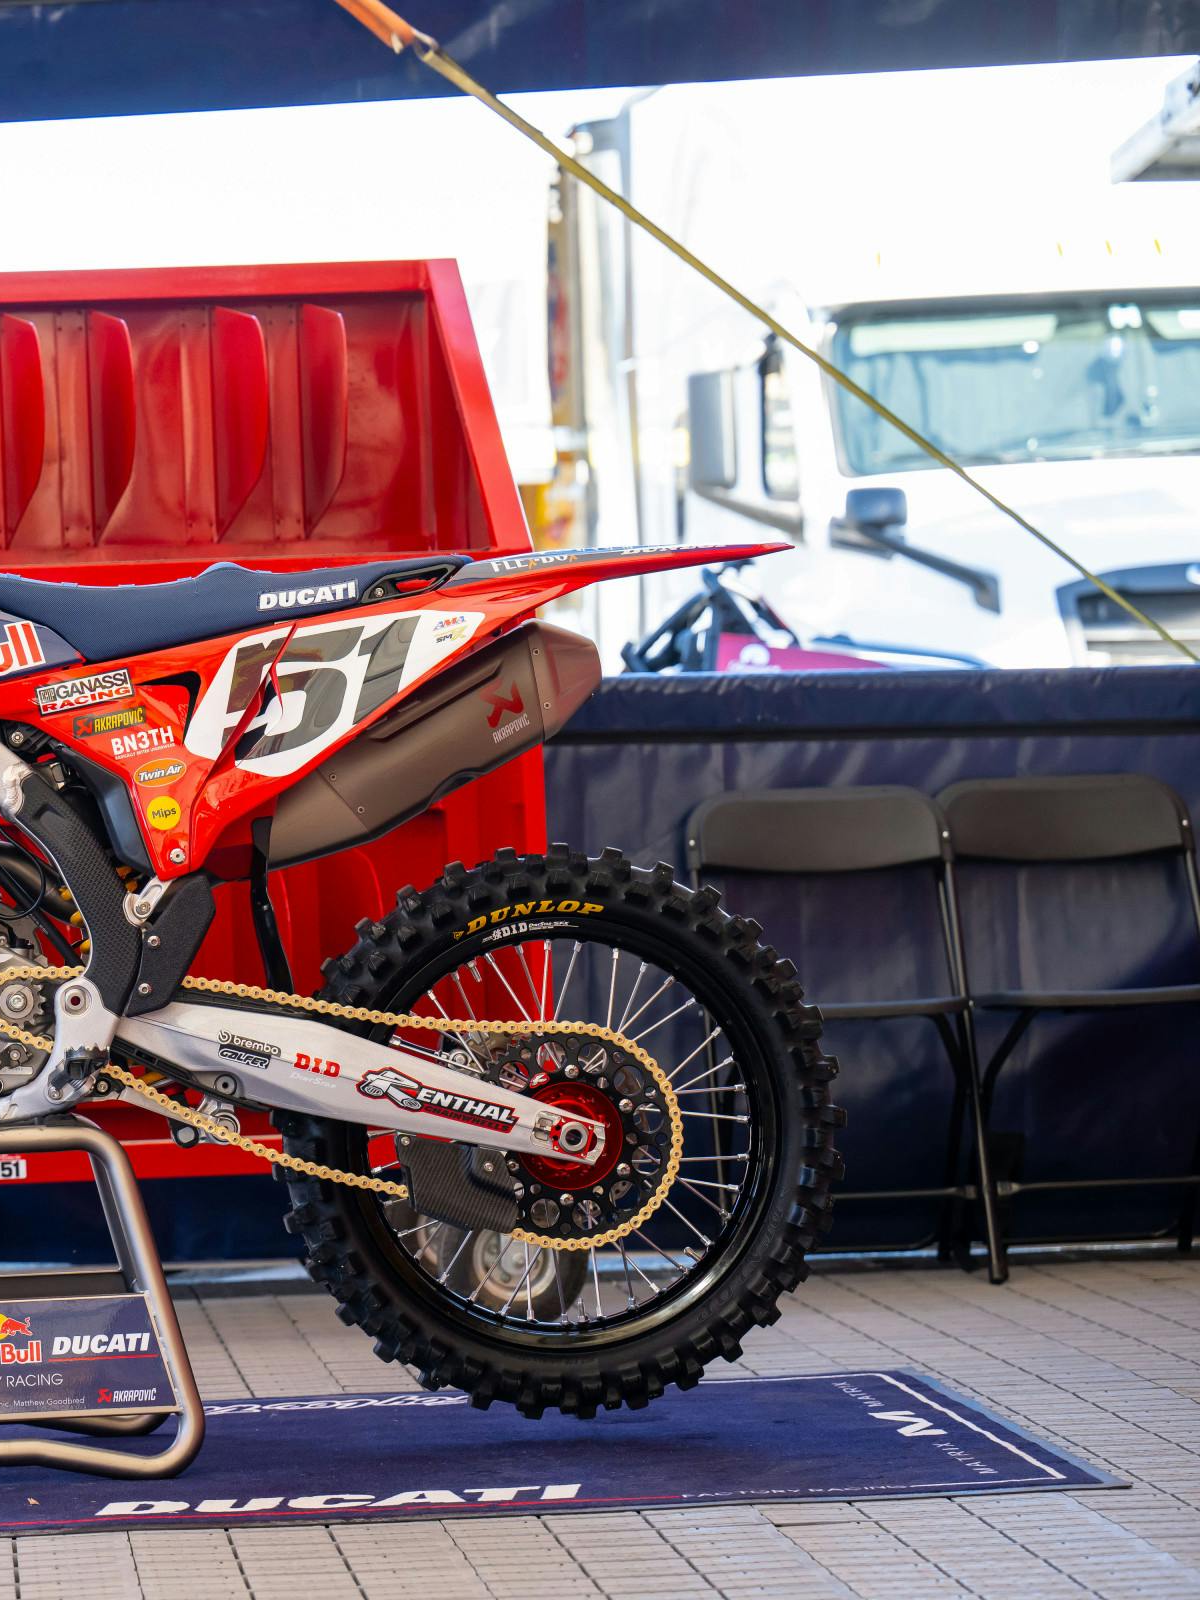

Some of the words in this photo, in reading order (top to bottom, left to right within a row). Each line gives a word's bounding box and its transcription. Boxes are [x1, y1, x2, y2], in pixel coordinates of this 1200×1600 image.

[259, 581, 356, 610] DUCATI
[55, 671, 128, 700] GANASSI
[221, 615, 421, 761] 51
[41, 686, 131, 713] RACING
[111, 725, 175, 756] BN3TH
[138, 768, 166, 782] Twin
[166, 764, 183, 775] Air
[151, 806, 177, 819] Mips
[466, 899, 605, 935] DUNLOP
[233, 1034, 280, 1056] brembo
[218, 1048, 270, 1070] GALFER
[0, 1161, 20, 1178] 51
[0, 1340, 42, 1366] Bull
[52, 1332, 150, 1355] DUCATI
[6, 1373, 64, 1388] RACING
[13, 1399, 45, 1408] Matthew
[95, 1483, 582, 1517] DUCATI
